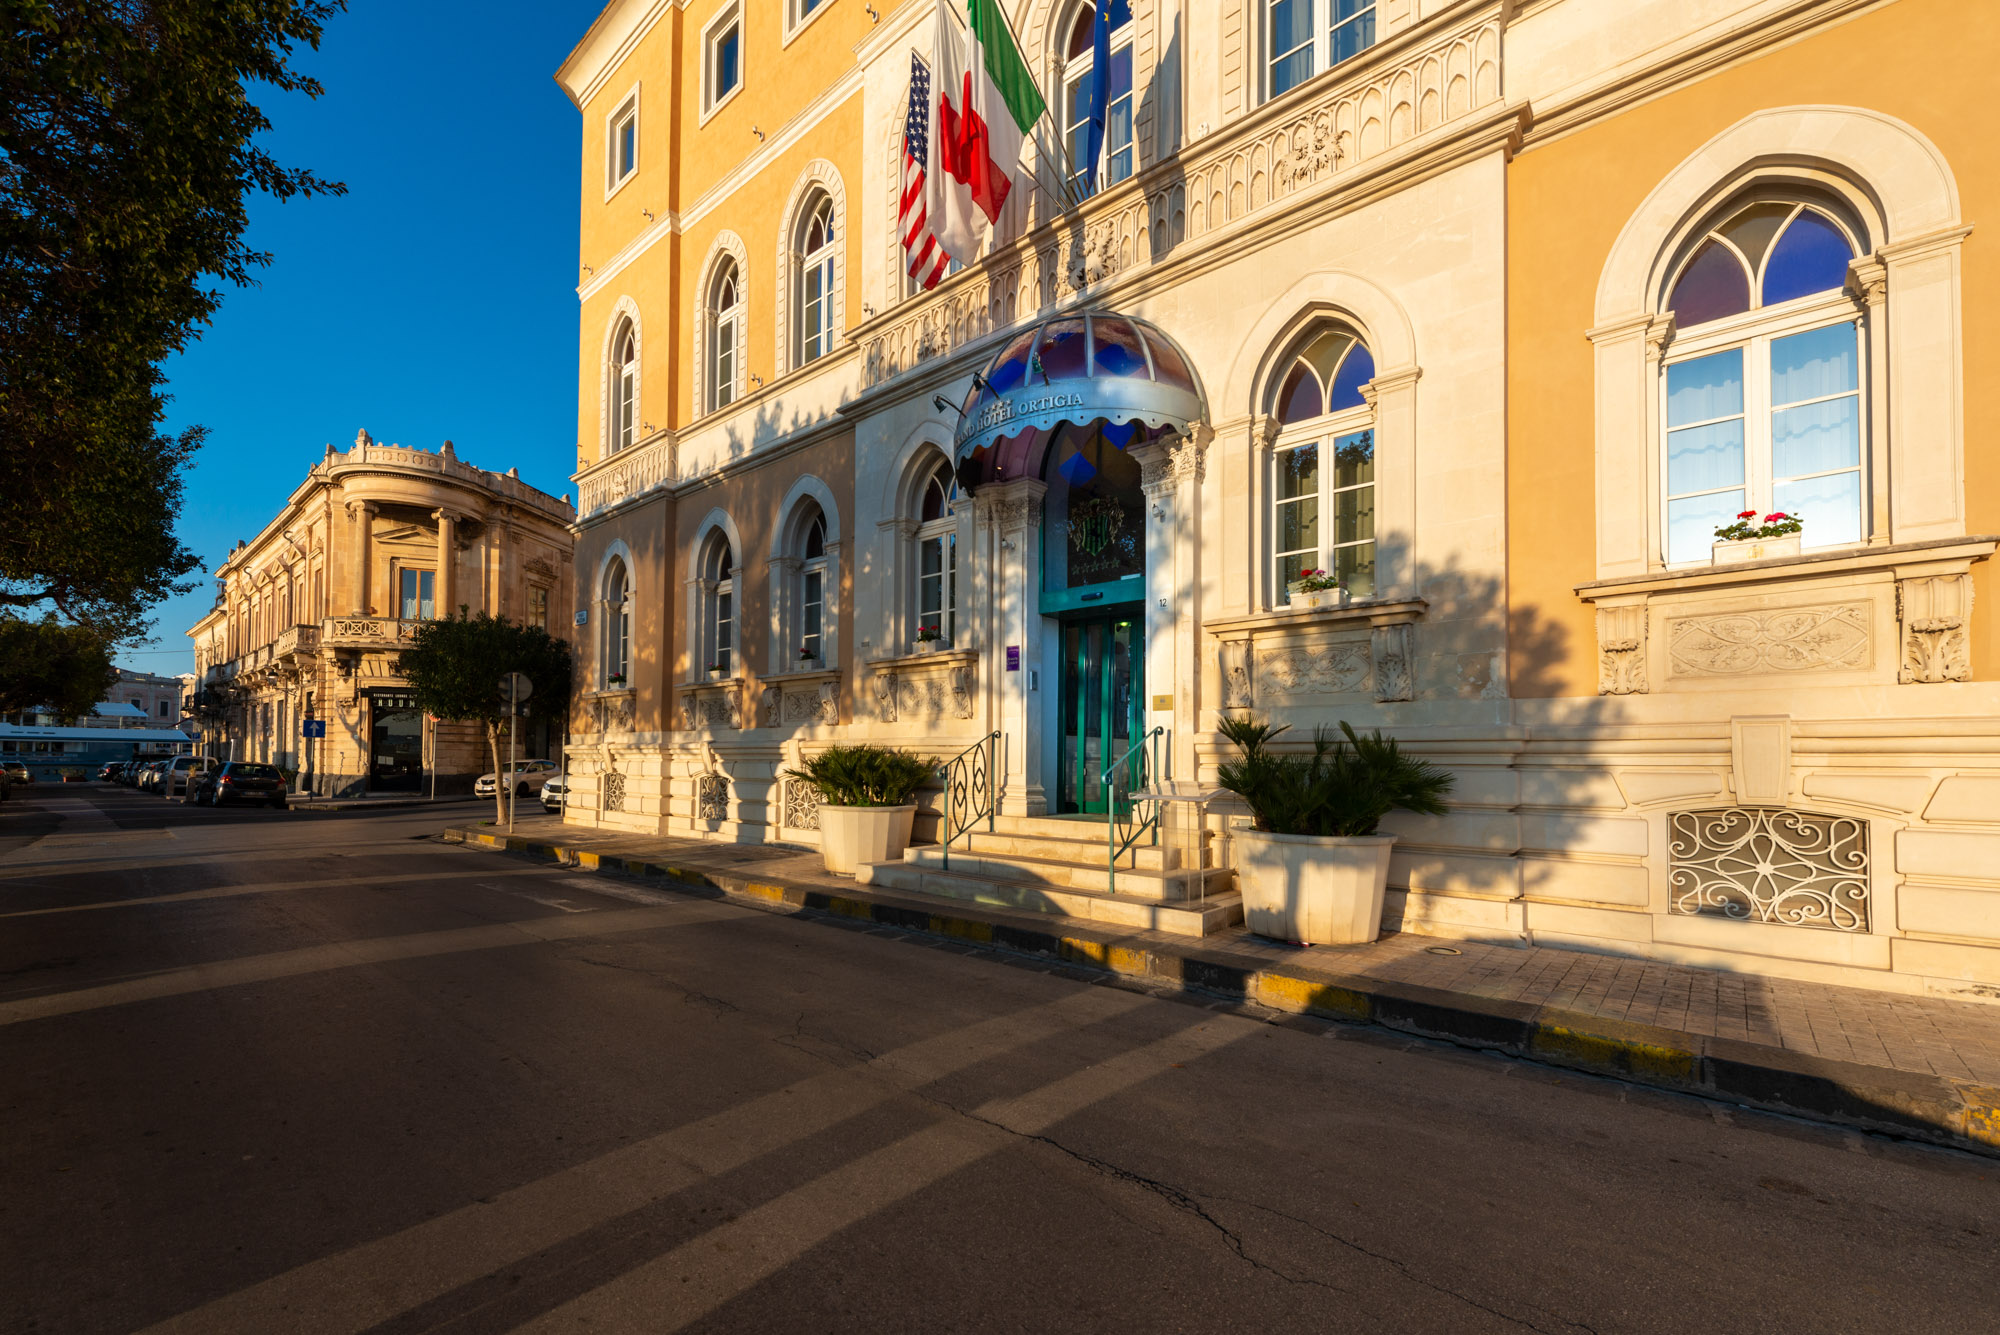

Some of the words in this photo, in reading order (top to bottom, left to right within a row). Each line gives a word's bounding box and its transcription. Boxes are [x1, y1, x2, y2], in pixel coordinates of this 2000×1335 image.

[977, 405, 1016, 433] HOTEL
[1019, 393, 1083, 415] ORTIGIA
[1159, 597, 1167, 608] 12
